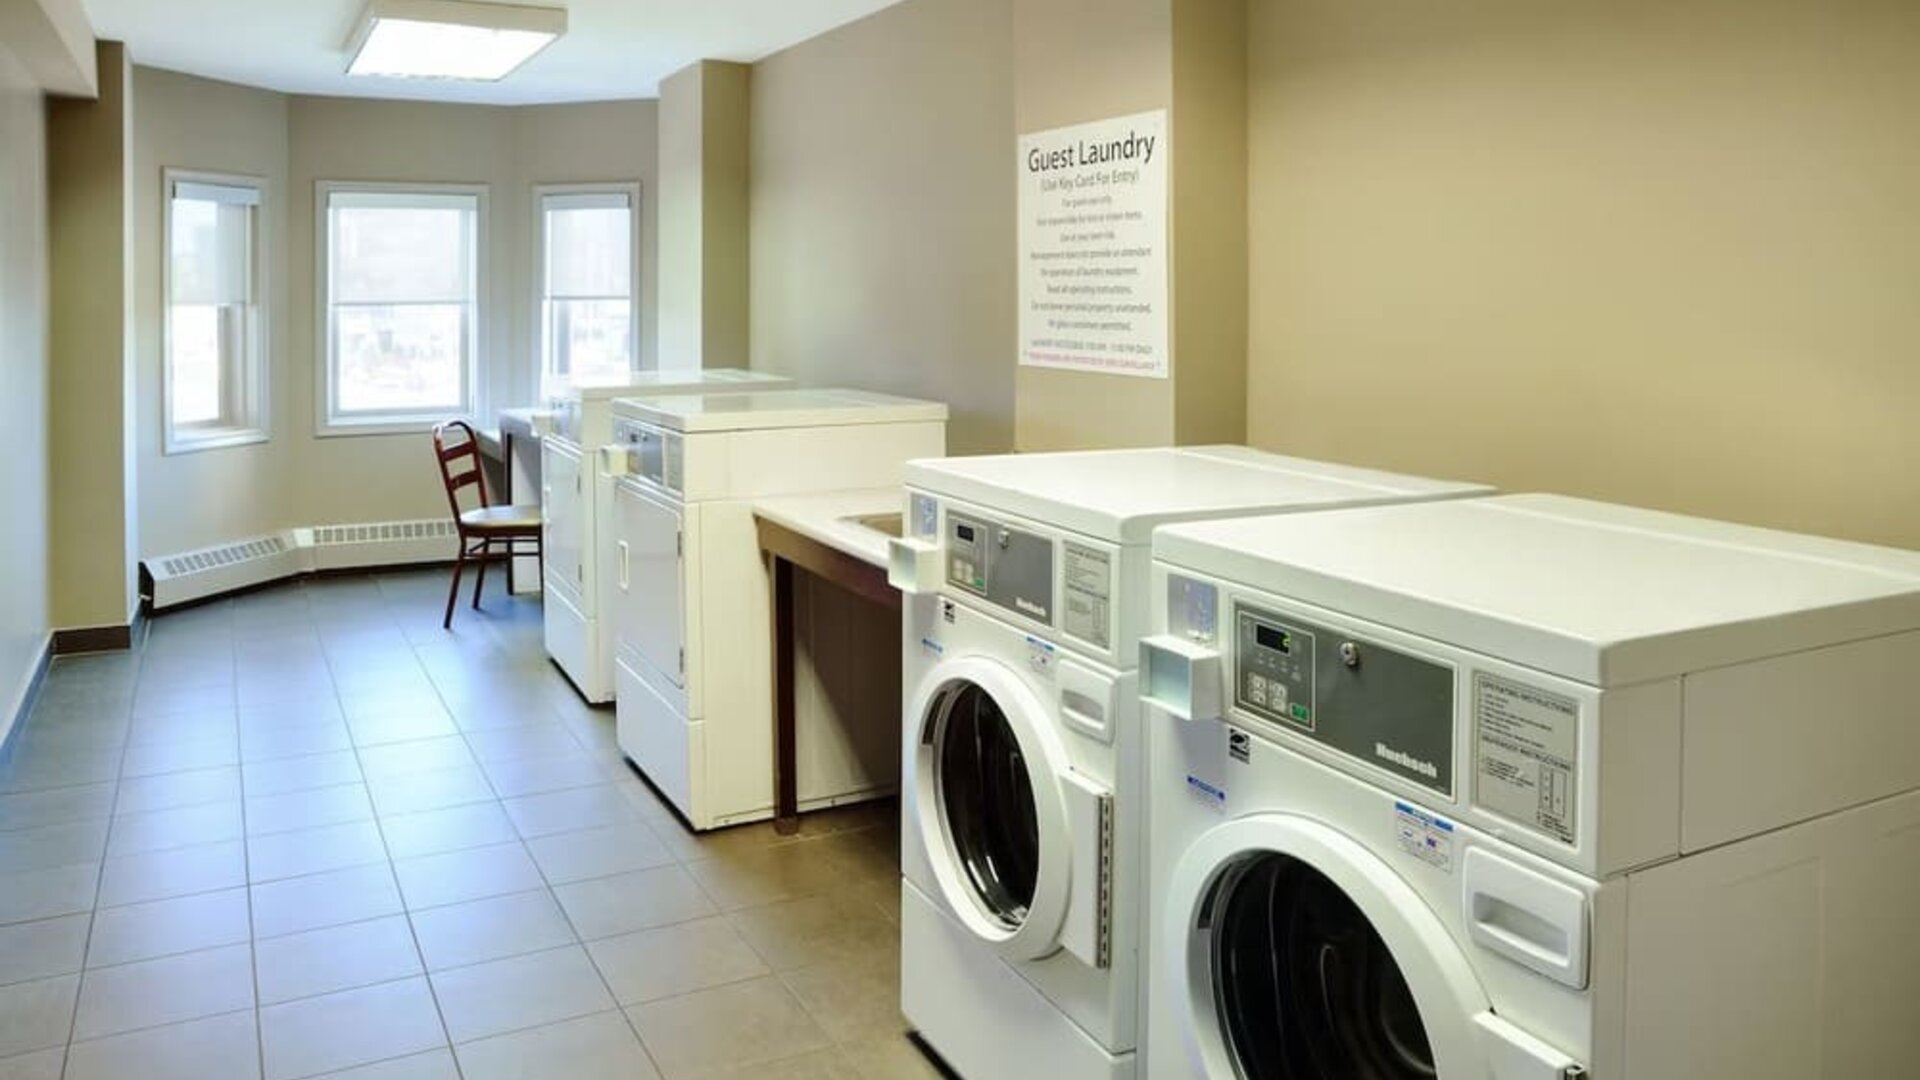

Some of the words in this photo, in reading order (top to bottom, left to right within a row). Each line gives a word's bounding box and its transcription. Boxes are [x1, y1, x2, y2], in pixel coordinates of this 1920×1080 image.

[1028, 146, 1074, 172] Guest
[1079, 130, 1155, 165] Laundry
[1059, 176, 1074, 192] Key
[1075, 172, 1095, 188] Card
[1096, 171, 1110, 185] For
